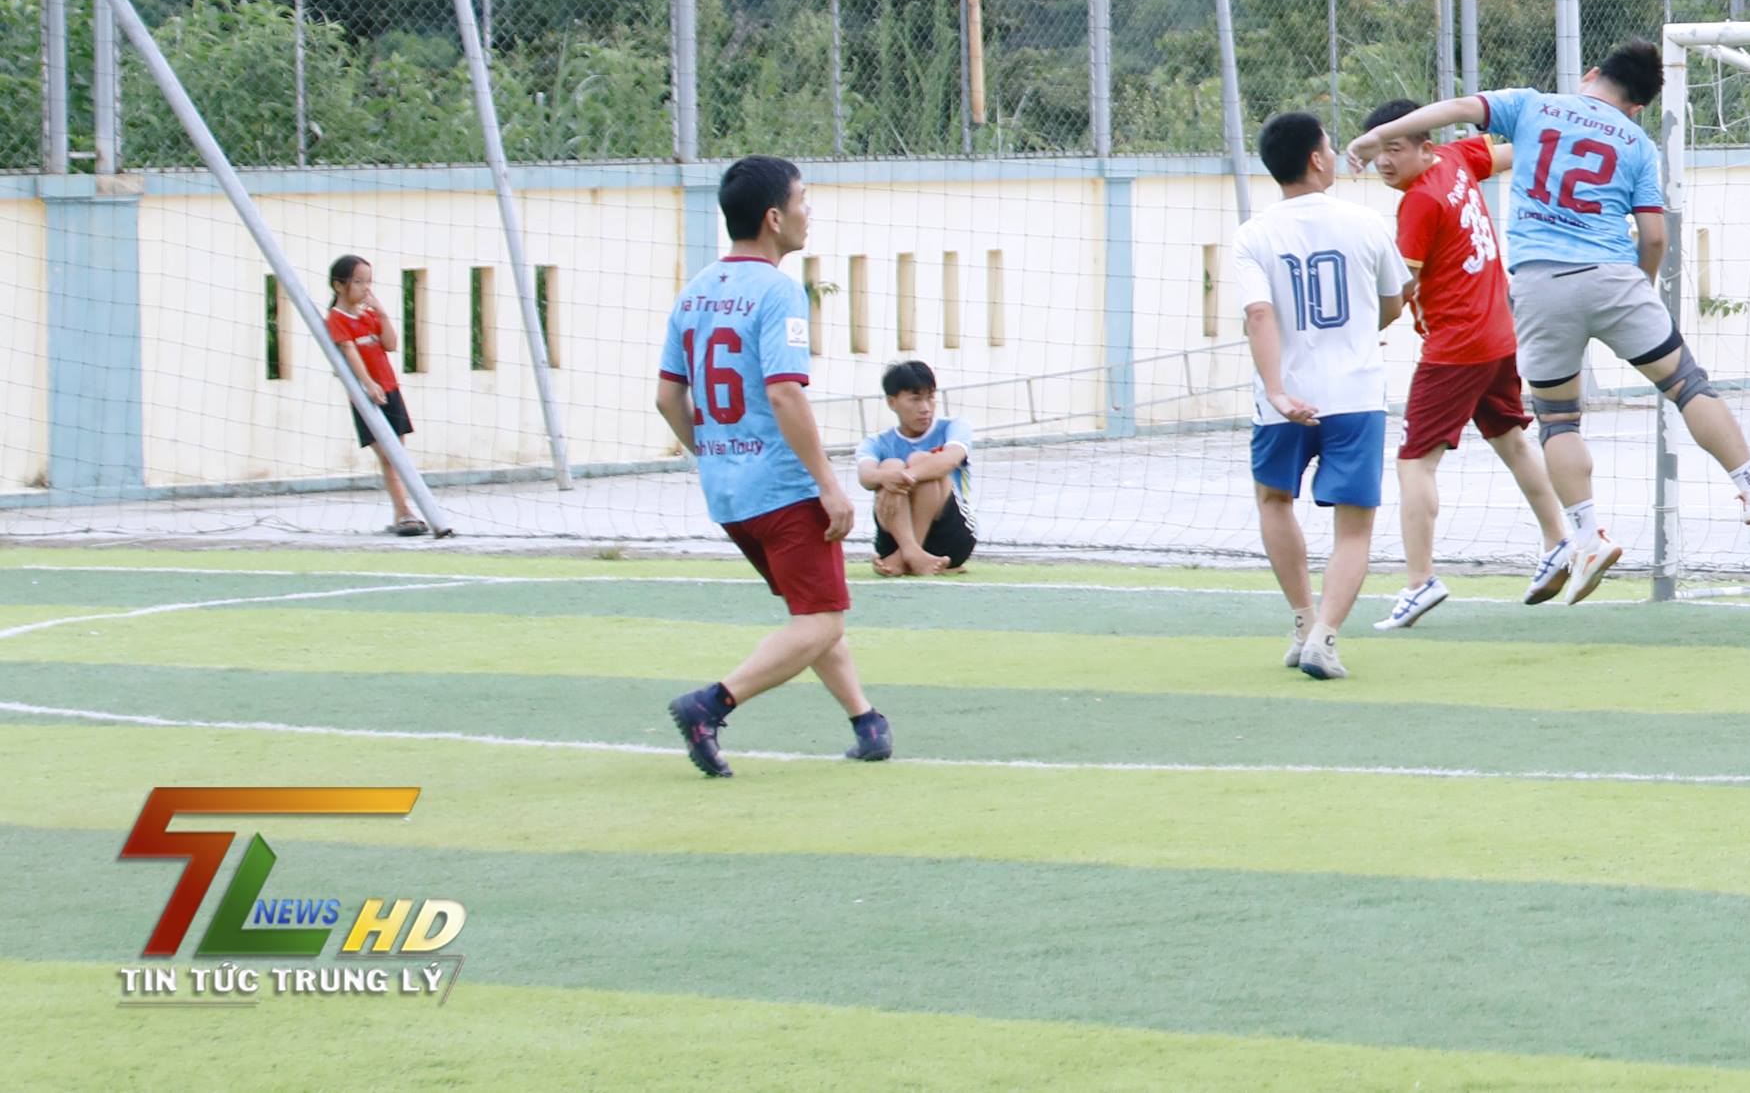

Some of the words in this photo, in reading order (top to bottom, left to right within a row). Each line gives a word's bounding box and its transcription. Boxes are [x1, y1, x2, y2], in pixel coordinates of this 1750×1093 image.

[1566, 110, 1616, 136] Trung
[1527, 128, 1617, 214] 12
[1278, 249, 1350, 331] 10
[683, 327, 746, 426] 16
